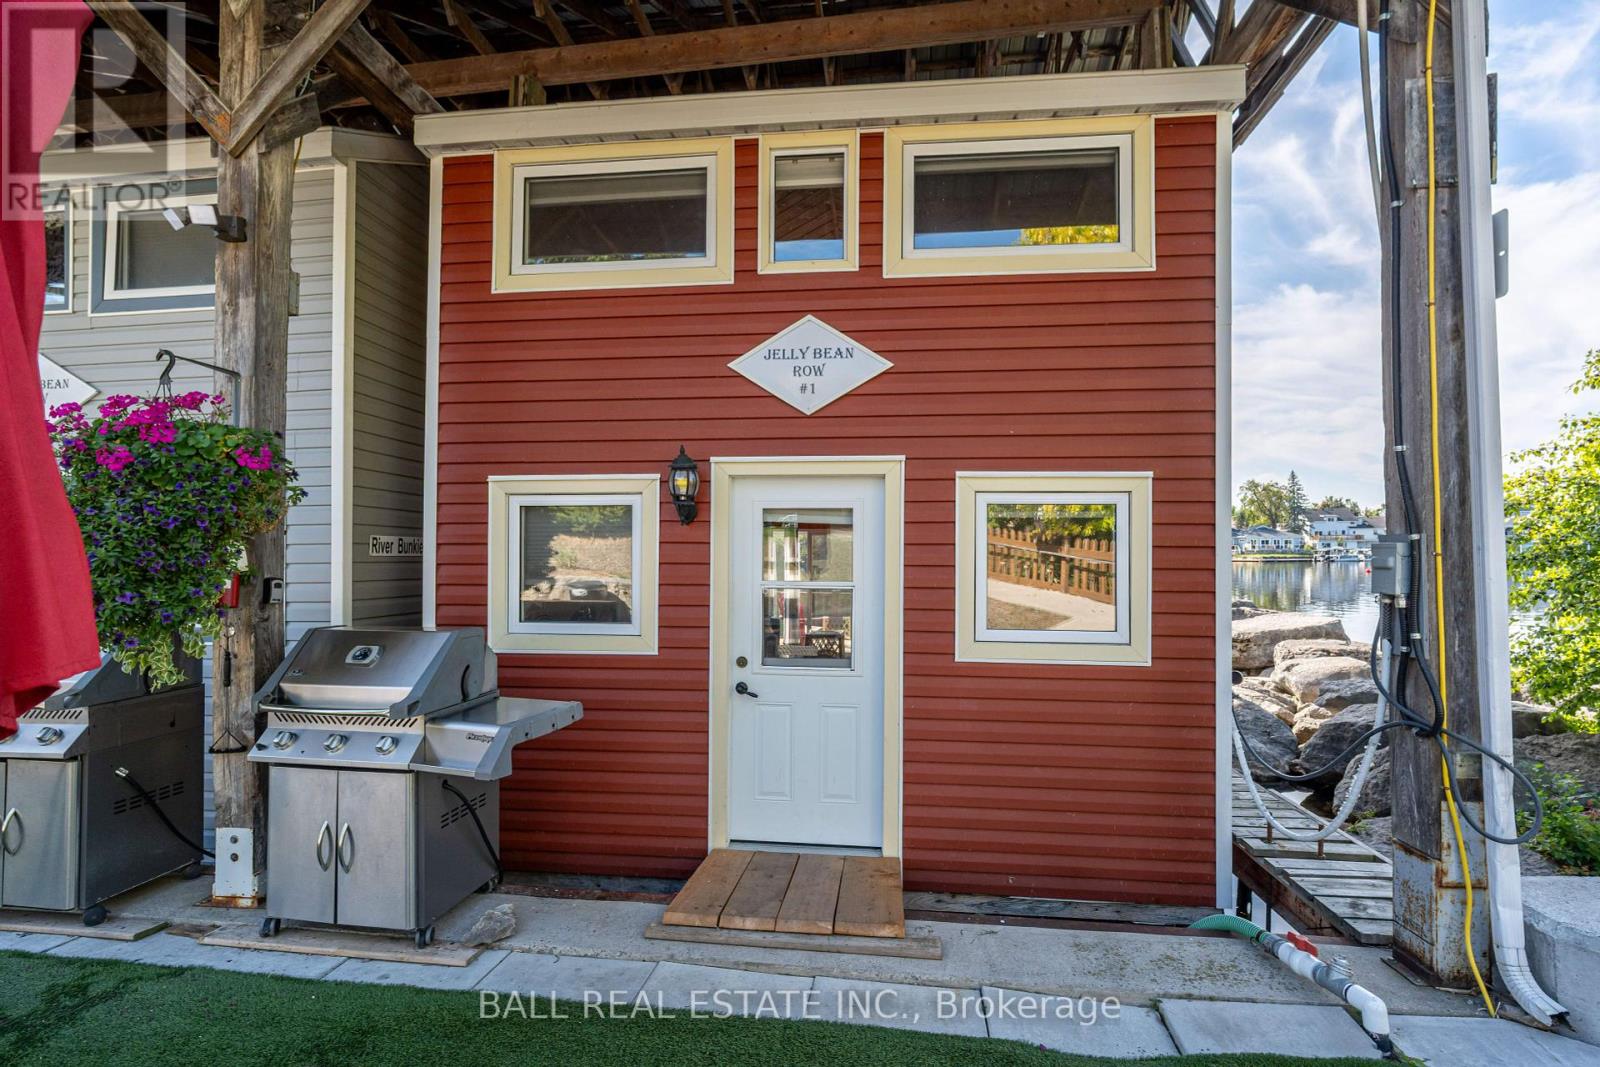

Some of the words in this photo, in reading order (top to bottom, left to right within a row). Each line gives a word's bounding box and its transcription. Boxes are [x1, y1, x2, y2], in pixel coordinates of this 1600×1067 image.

[763, 346, 810, 361] JELLY
[813, 347, 854, 360] BEAN
[792, 363, 826, 377] ROW
[799, 383, 816, 395] #1
[371, 537, 394, 554] River
